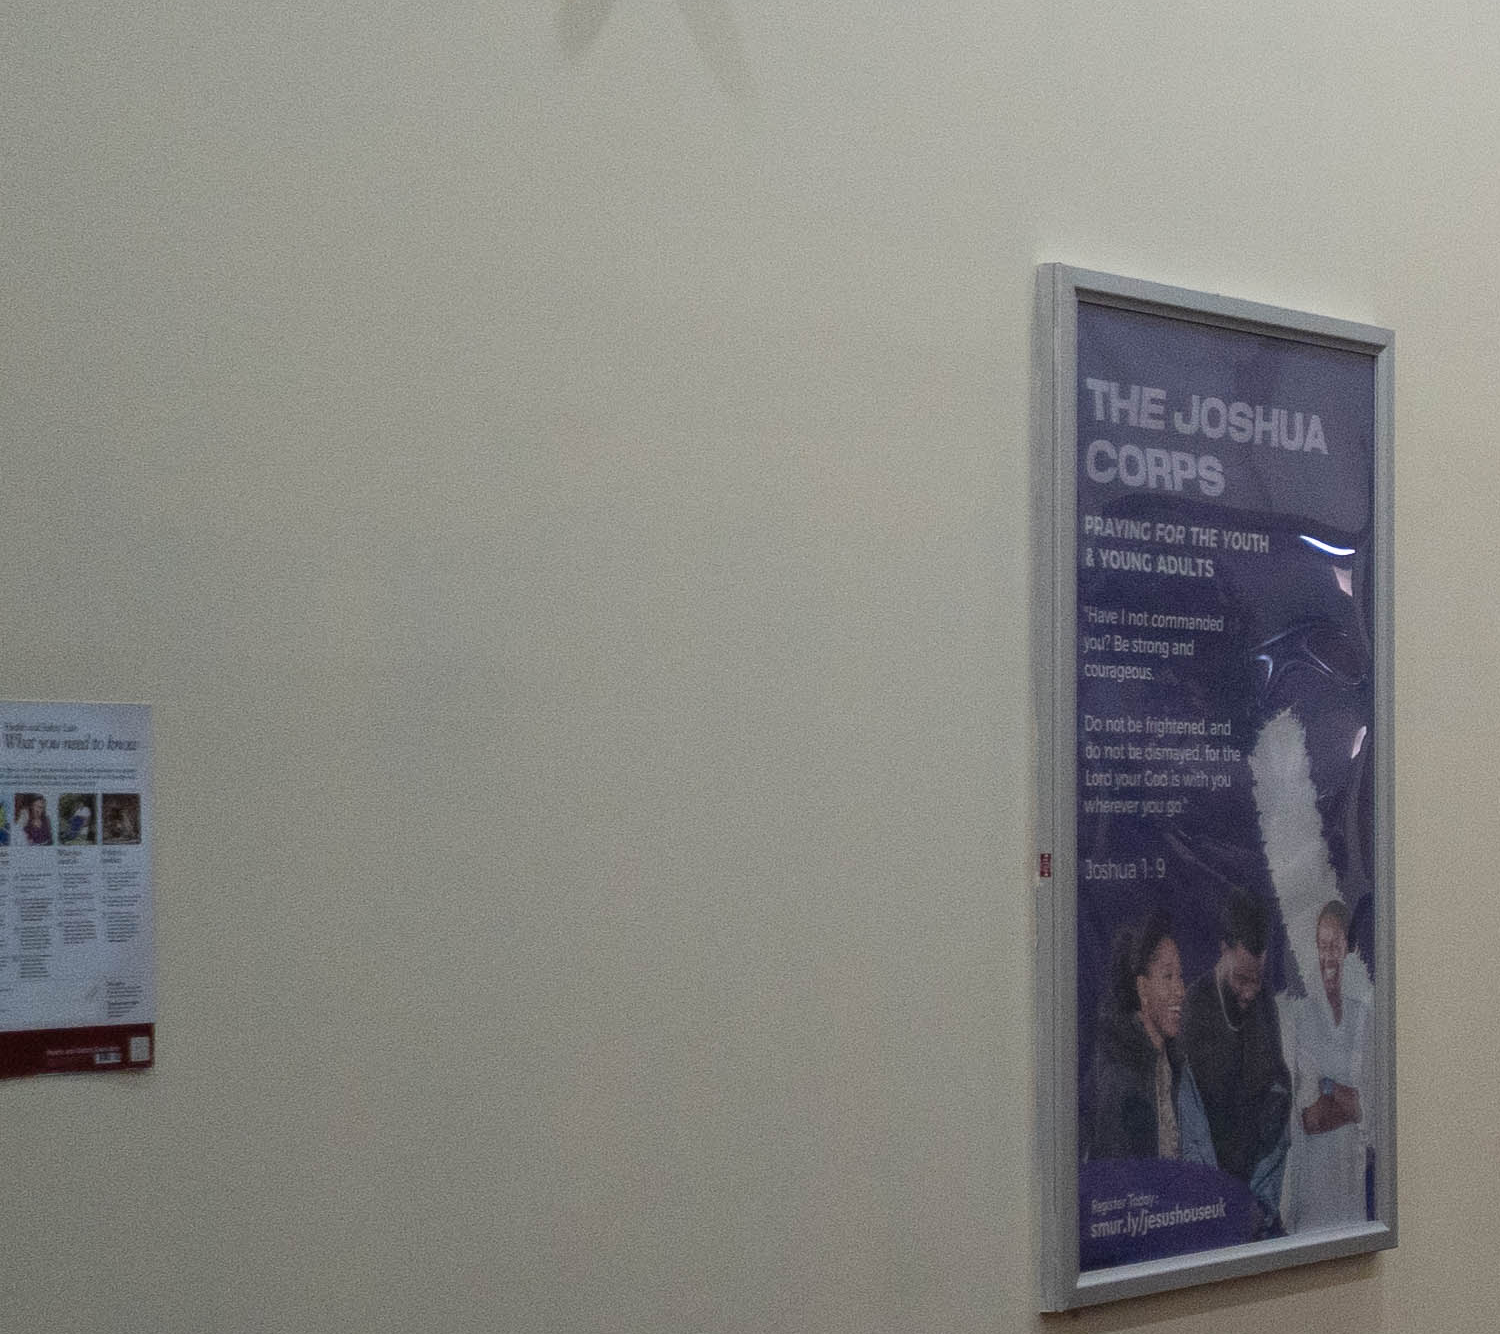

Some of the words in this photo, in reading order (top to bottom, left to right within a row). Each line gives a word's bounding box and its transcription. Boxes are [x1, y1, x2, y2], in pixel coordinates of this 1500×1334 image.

[1086, 378, 1167, 430] THE
[1174, 394, 1329, 455] JOSHUA
[1086, 439, 1226, 497] CORPS
[1085, 516, 1150, 541] PRAYING
[1155, 523, 1186, 544] FOR
[1190, 527, 1217, 548] THE
[1223, 530, 1269, 553] YOUTH
[1086, 547, 1095, 567] &
[1099, 548, 1152, 572] YOUNG
[1157, 554, 1214, 577] ADULTS
[1128, 611, 1149, 626] not
[1151, 614, 1224, 632] commanded
[1083, 635, 1110, 653] you?
[1114, 635, 1129, 651] Be
[1132, 638, 1169, 658] strong
[1172, 640, 1194, 656] and
[1084, 664, 1155, 683] courageous.
[1085, 715, 1102, 732] Do
[1106, 717, 1125, 733] not
[1128, 717, 1143, 733] be
[1211, 719, 1231, 736] and
[1086, 741, 1101, 759] do
[1104, 744, 1125, 759] not
[1128, 743, 1142, 759] be
[1205, 744, 1220, 761] for
[1223, 746, 1241, 762] the
[1086, 770, 1112, 786] Lord
[1115, 772, 1142, 790] your
[1144, 770, 1168, 786] God
[1171, 770, 1180, 787] is
[1183, 771, 1208, 787] with
[1211, 773, 1232, 791] you
[1084, 797, 1138, 813] wherever
[1142, 800, 1164, 817] you
[1085, 858, 1136, 879] Joshua
[1091, 1196, 1226, 1238] smur.ly/jesushouseuk
